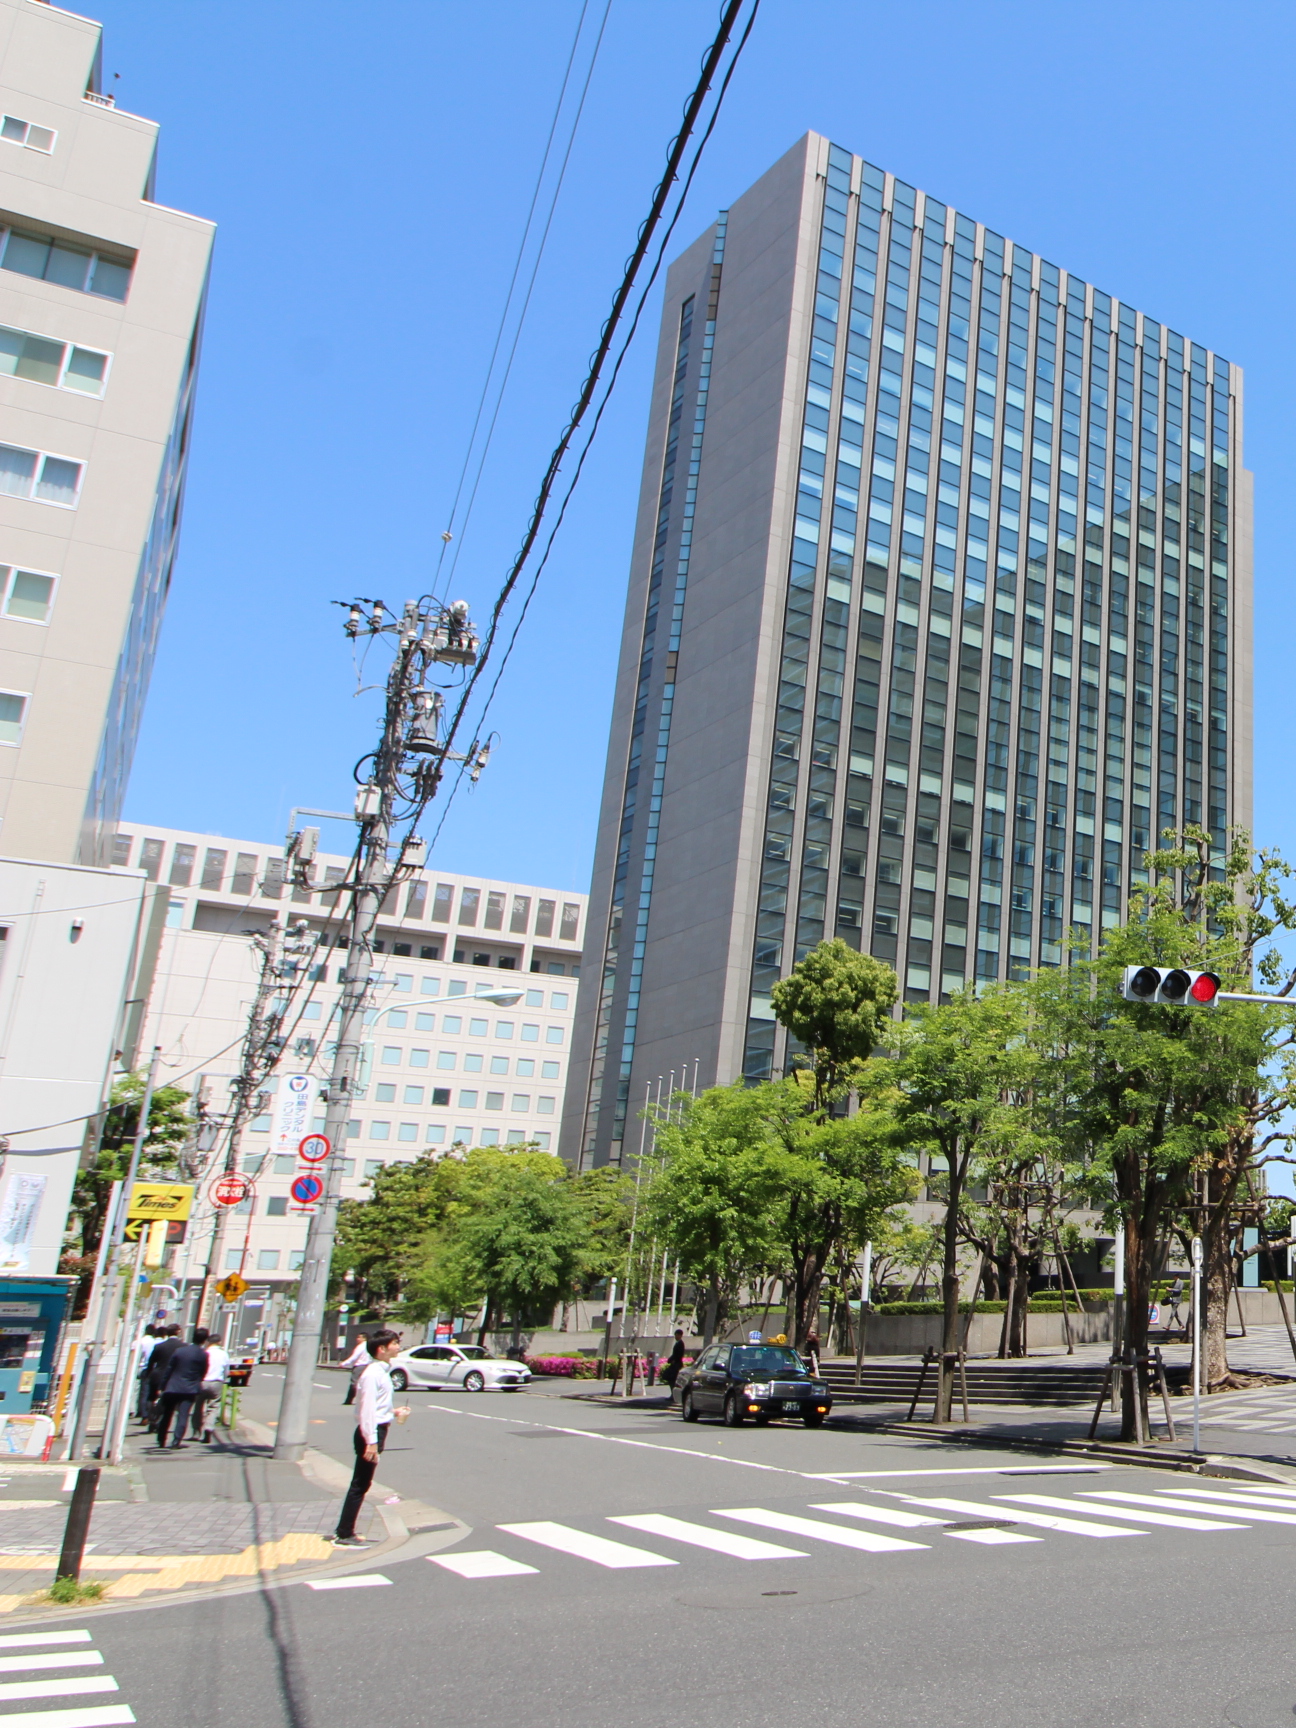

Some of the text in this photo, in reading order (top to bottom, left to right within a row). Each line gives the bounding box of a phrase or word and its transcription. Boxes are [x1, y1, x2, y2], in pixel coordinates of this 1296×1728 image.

[280, 1101, 295, 1133] クリニック
[292, 1093, 308, 1133] 田島デンタル
[305, 1142, 324, 1154] 30
[217, 1187, 244, 1197] 消火栓
[137, 1195, 180, 1209] Times
